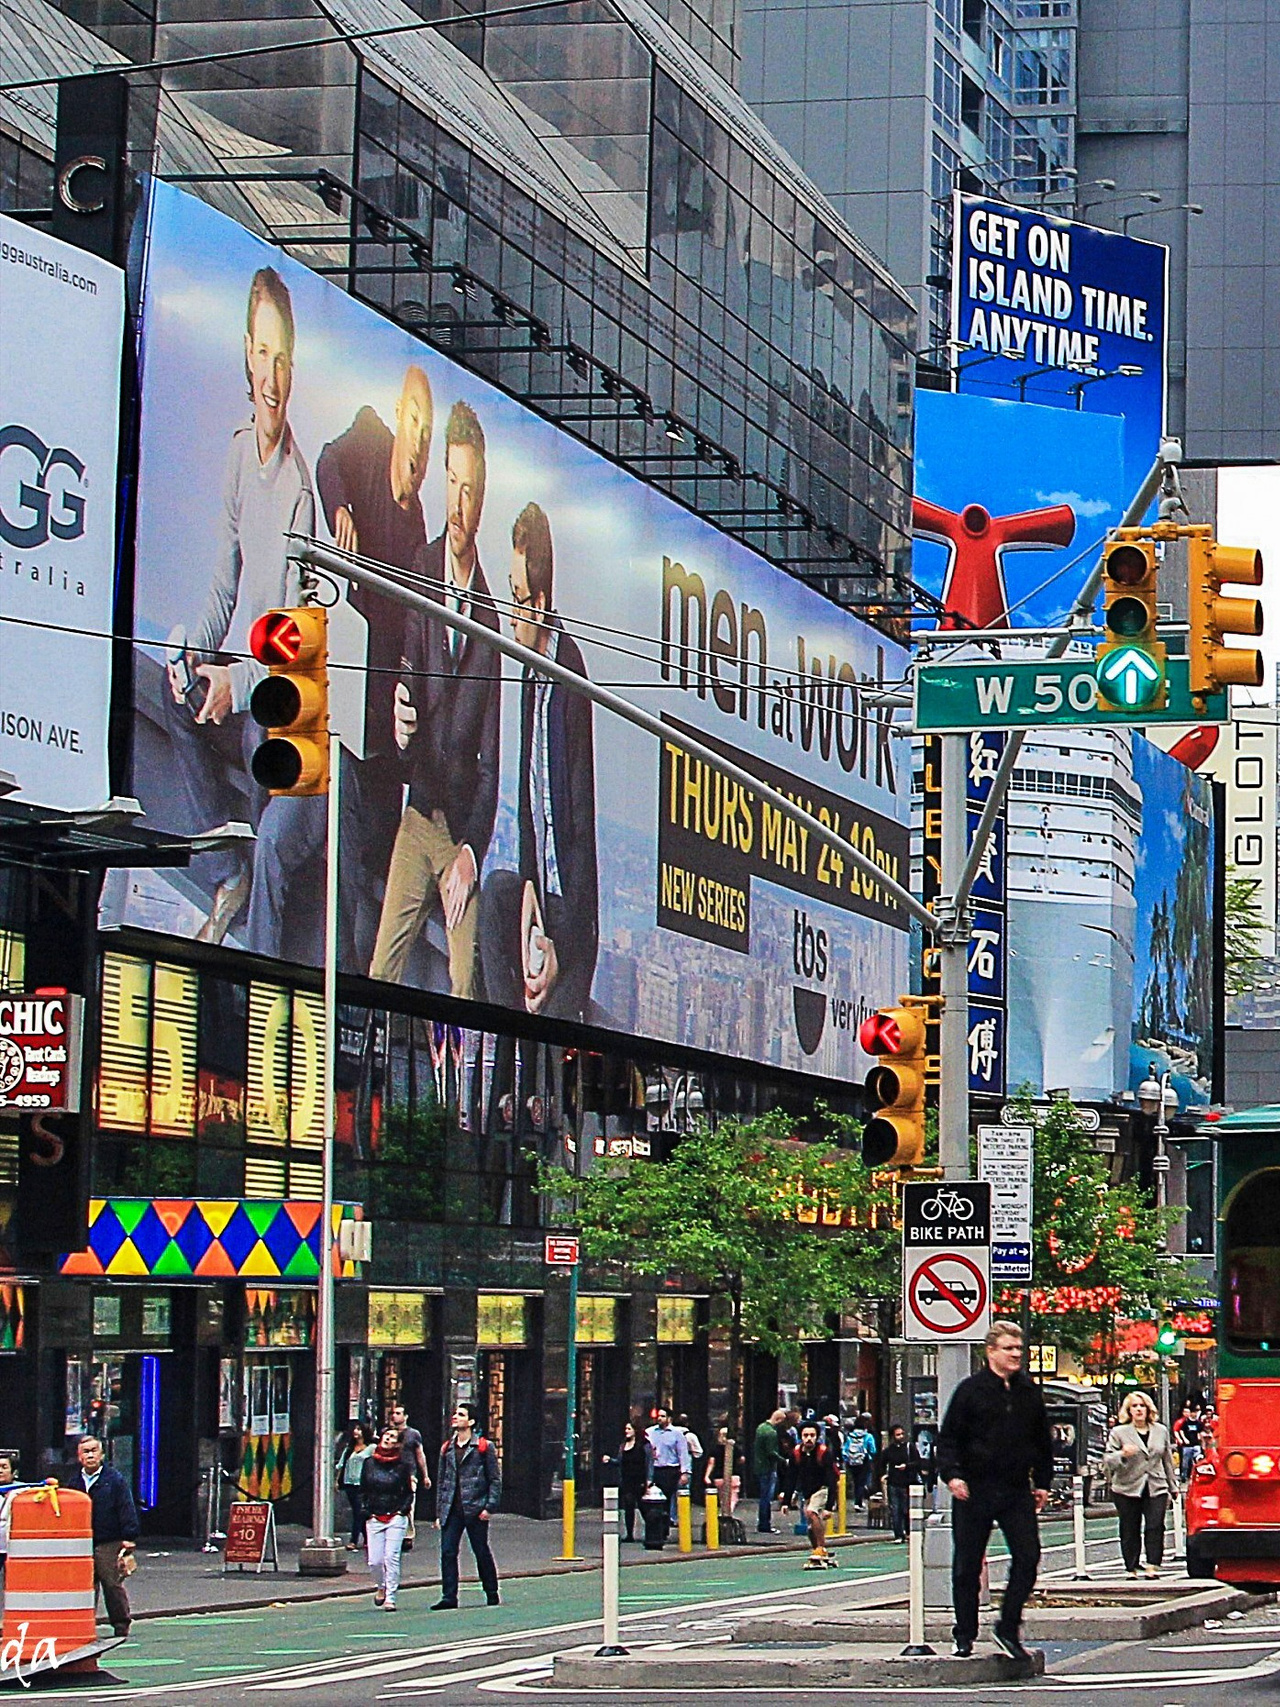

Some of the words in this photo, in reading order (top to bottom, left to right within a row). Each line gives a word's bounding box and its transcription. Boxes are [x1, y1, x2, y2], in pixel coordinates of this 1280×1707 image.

[0, 242, 98, 296] ggaustralia.com
[968, 210, 1018, 260] GET
[1028, 224, 1070, 274] ON
[968, 257, 1073, 320] ISLAND
[1081, 285, 1154, 342] TIME.
[660, 555, 767, 730] men
[771, 677, 794, 743] at
[797, 635, 897, 795] work
[975, 675, 1014, 714] W
[47, 721, 84, 755] AVE.
[664, 741, 755, 854] THURS
[662, 862, 696, 916] NEW
[698, 881, 747, 934] SERIES
[793, 908, 829, 982] tbs
[910, 1226, 943, 1240] BIKE
[947, 1225, 985, 1240] PATH
[1009, 1246, 1018, 1255] at
